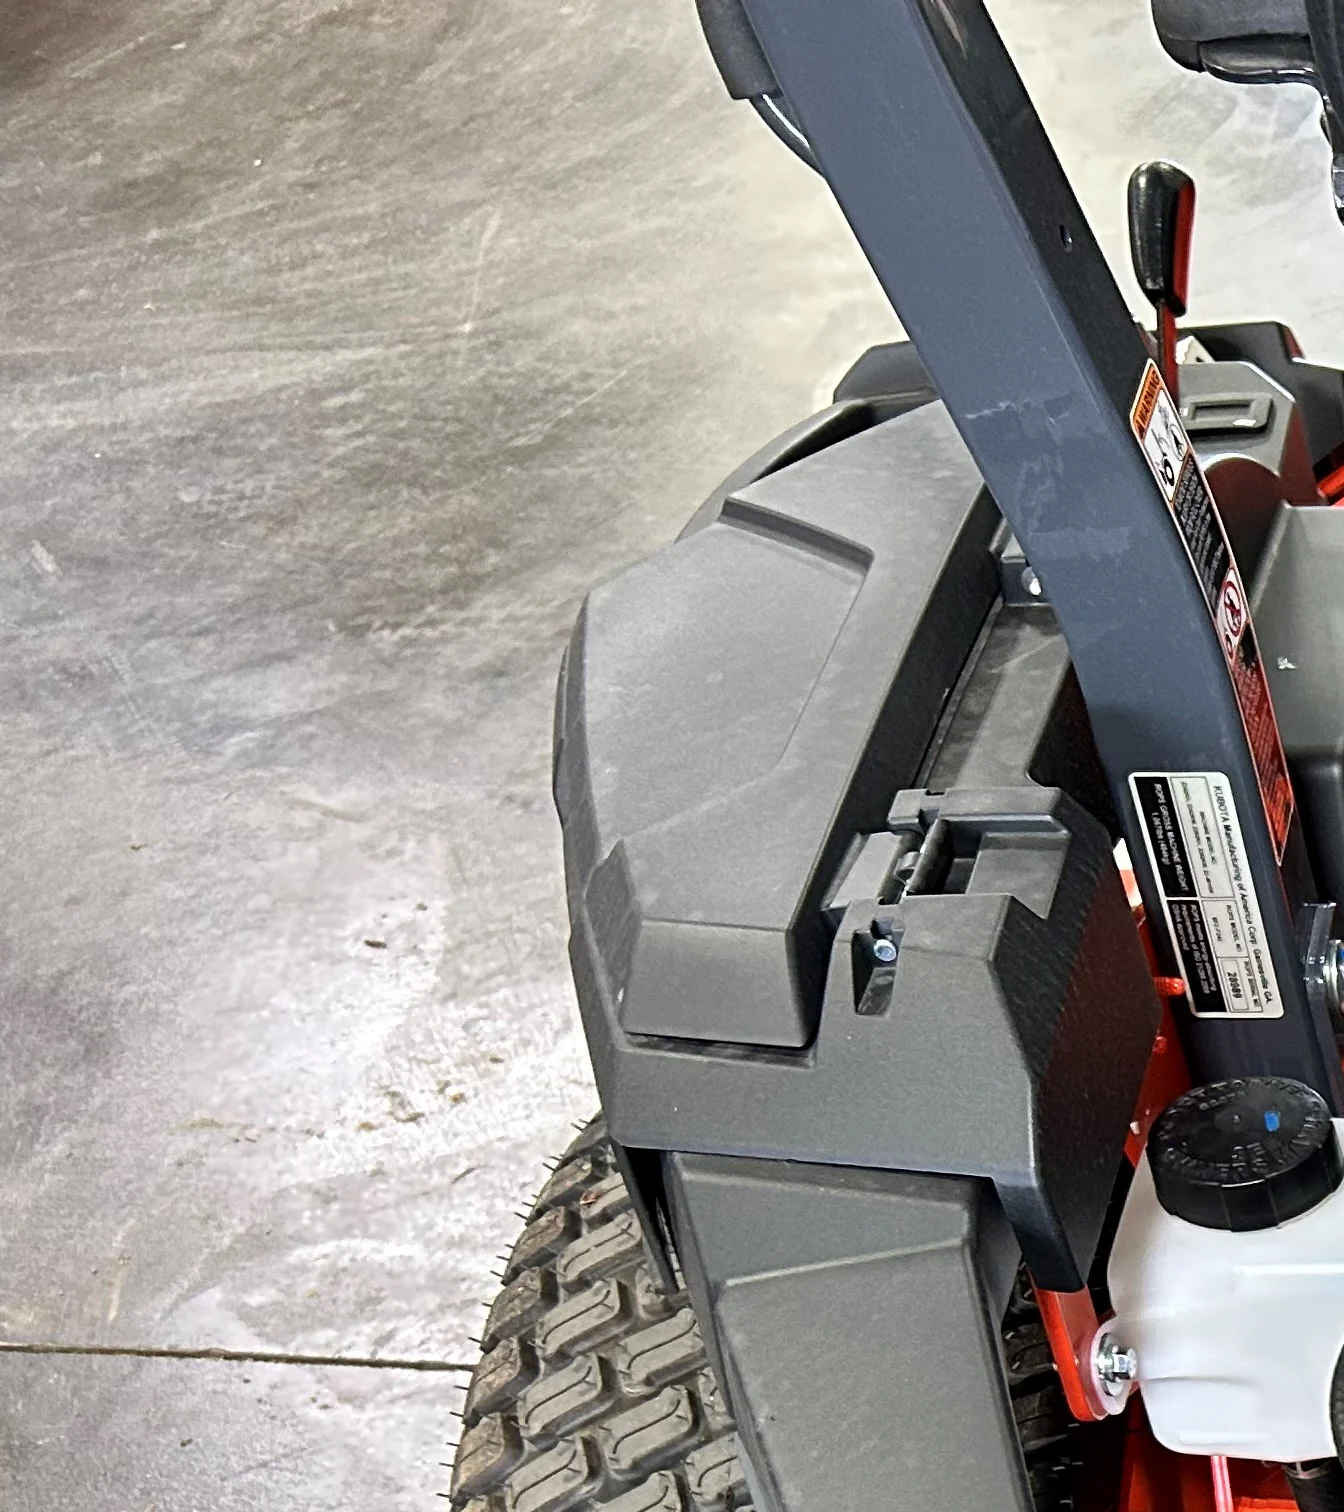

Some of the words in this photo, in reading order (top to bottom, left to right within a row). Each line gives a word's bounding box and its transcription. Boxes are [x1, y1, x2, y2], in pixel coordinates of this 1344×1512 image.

[1153, 783, 1165, 803] ROPS
[1159, 805, 1172, 830] GROSS
[1165, 832, 1181, 863] MACHINE
[1214, 785, 1228, 822] KUBOTA
[1222, 824, 1242, 880] Manufacturing
[1240, 893, 1252, 924] America
[1174, 865, 1188, 891] WEIGHT
